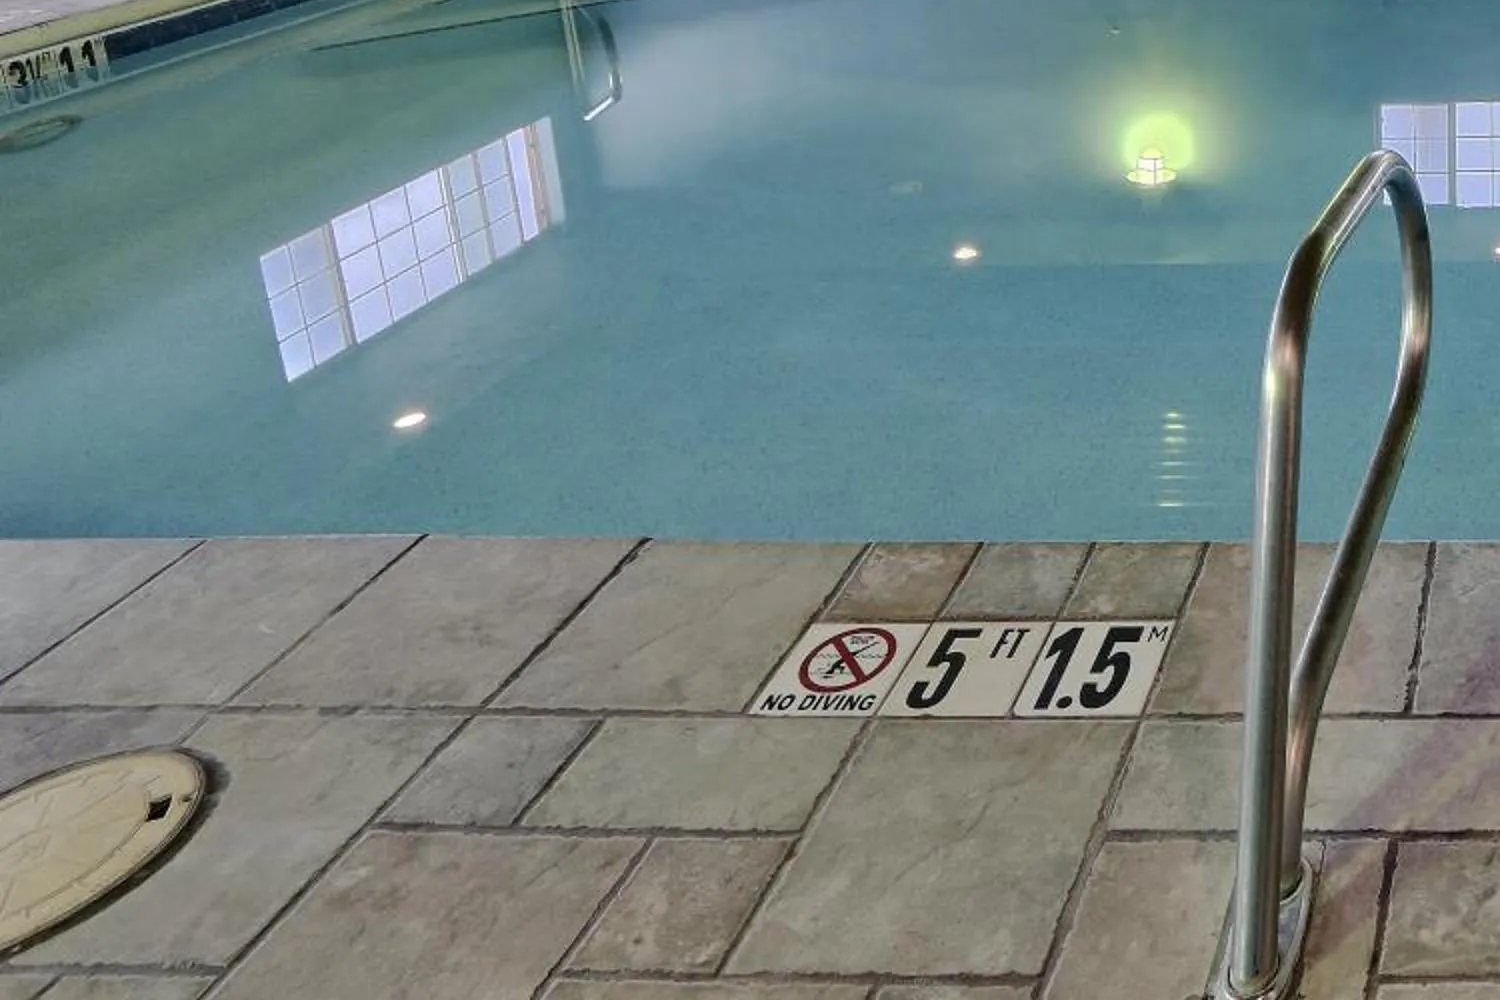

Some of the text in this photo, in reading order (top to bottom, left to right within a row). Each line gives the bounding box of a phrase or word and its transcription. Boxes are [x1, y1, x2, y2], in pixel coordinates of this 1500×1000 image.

[905, 626, 1169, 710] 5 FT 1.5 M
[760, 694, 877, 711] NO DIVING
